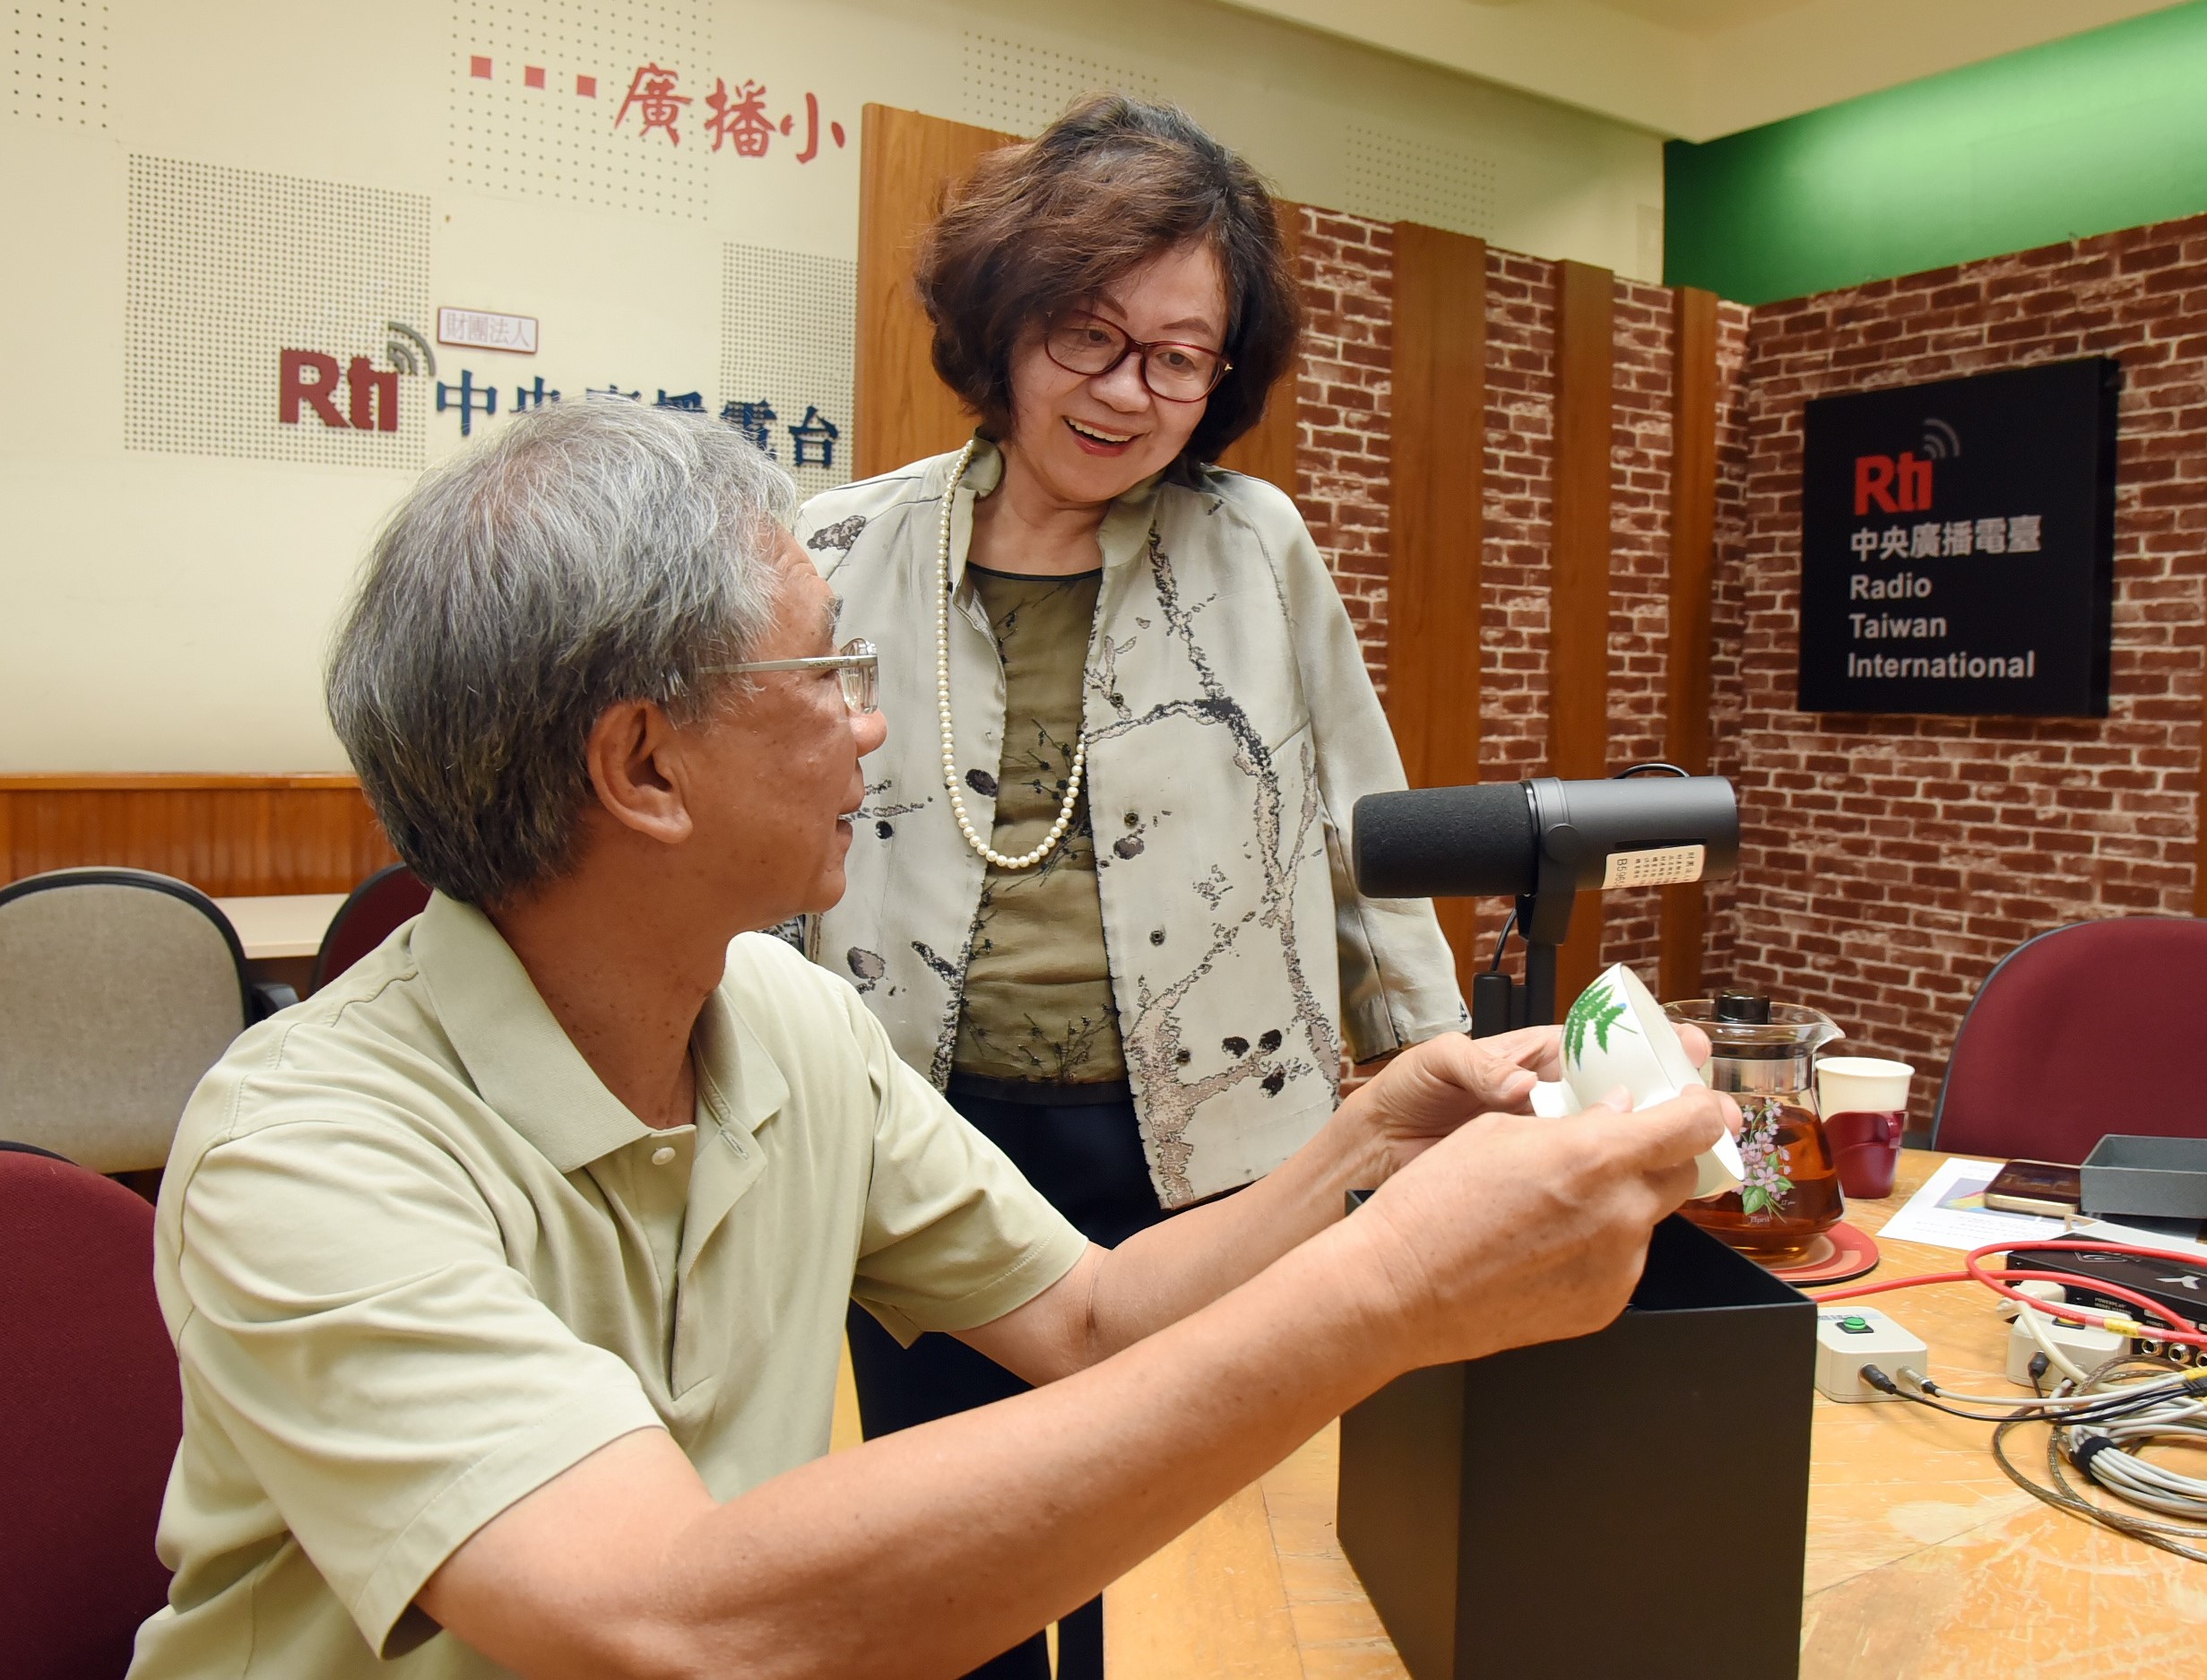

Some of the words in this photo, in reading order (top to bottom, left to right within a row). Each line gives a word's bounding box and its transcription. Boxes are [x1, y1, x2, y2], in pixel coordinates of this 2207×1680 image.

[614, 62, 845, 164] 廣播小
[446, 312, 531, 348] 財團法人
[1850, 514, 2042, 562] 中央廣播電臺
[1850, 572, 1933, 600] Radio
[1848, 613, 1947, 639] Taiwan
[1847, 650, 2036, 679] International
